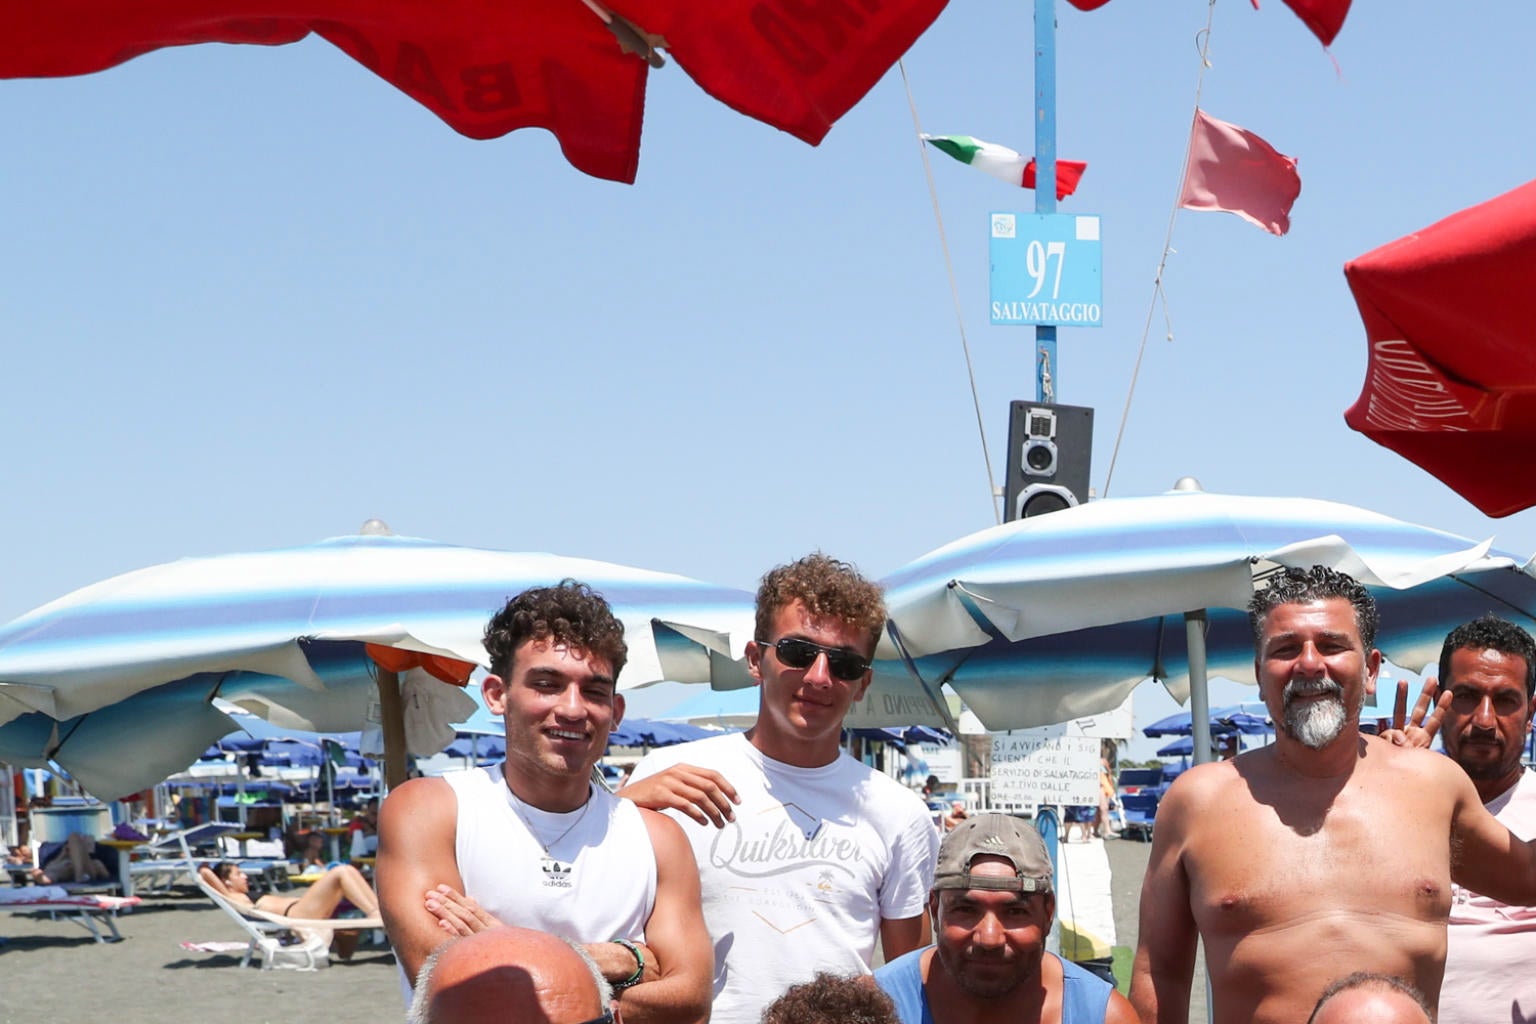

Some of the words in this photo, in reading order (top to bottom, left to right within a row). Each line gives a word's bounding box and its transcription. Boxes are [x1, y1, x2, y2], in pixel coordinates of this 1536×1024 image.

[1026, 240, 1066, 299] 97
[992, 301, 1101, 322] SALVATAGGIO
[710, 818, 864, 872] Quiksilver
[542, 880, 572, 888] adidas
